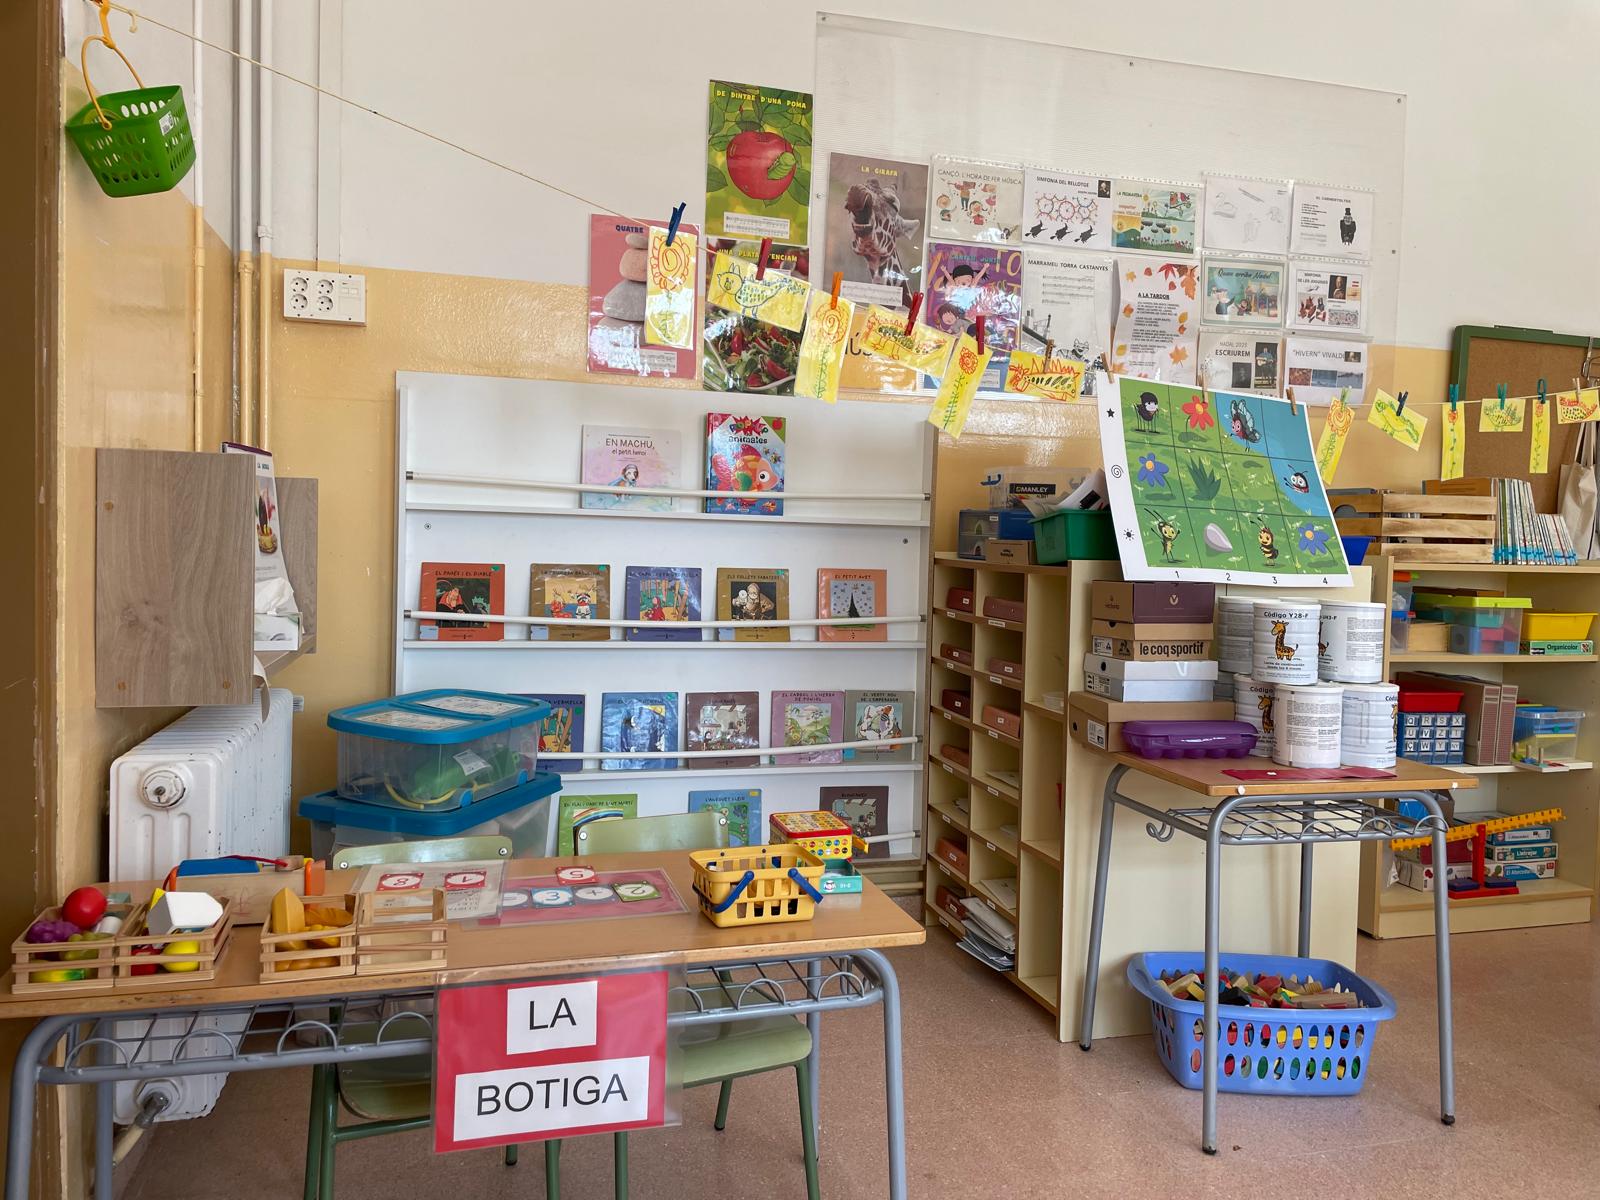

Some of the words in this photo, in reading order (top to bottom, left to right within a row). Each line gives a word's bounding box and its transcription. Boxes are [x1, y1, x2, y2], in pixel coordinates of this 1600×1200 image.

[730, 92, 756, 100] DINTRE
[760, 96, 782, 104] D'UNA
[786, 100, 806, 109] POMA
[874, 168, 898, 177] GIRAFA
[1002, 176, 1022, 185] MÚSICA
[1036, 176, 1058, 184] SIMFONIA
[616, 224, 644, 233] QUATRE
[606, 438, 618, 447] EN
[620, 439, 655, 450] MACHU,
[1174, 570, 1179, 578] 1
[1226, 572, 1231, 581] 2
[1272, 576, 1278, 584] 3
[1322, 576, 1328, 585] 4
[1263, 611, 1287, 619] Código
[1140, 642, 1149, 656] le
[1150, 644, 1169, 662] coq
[1171, 641, 1204, 658] sportif
[529, 998, 576, 1030] LA
[476, 1073, 628, 1116] BOTIGA
